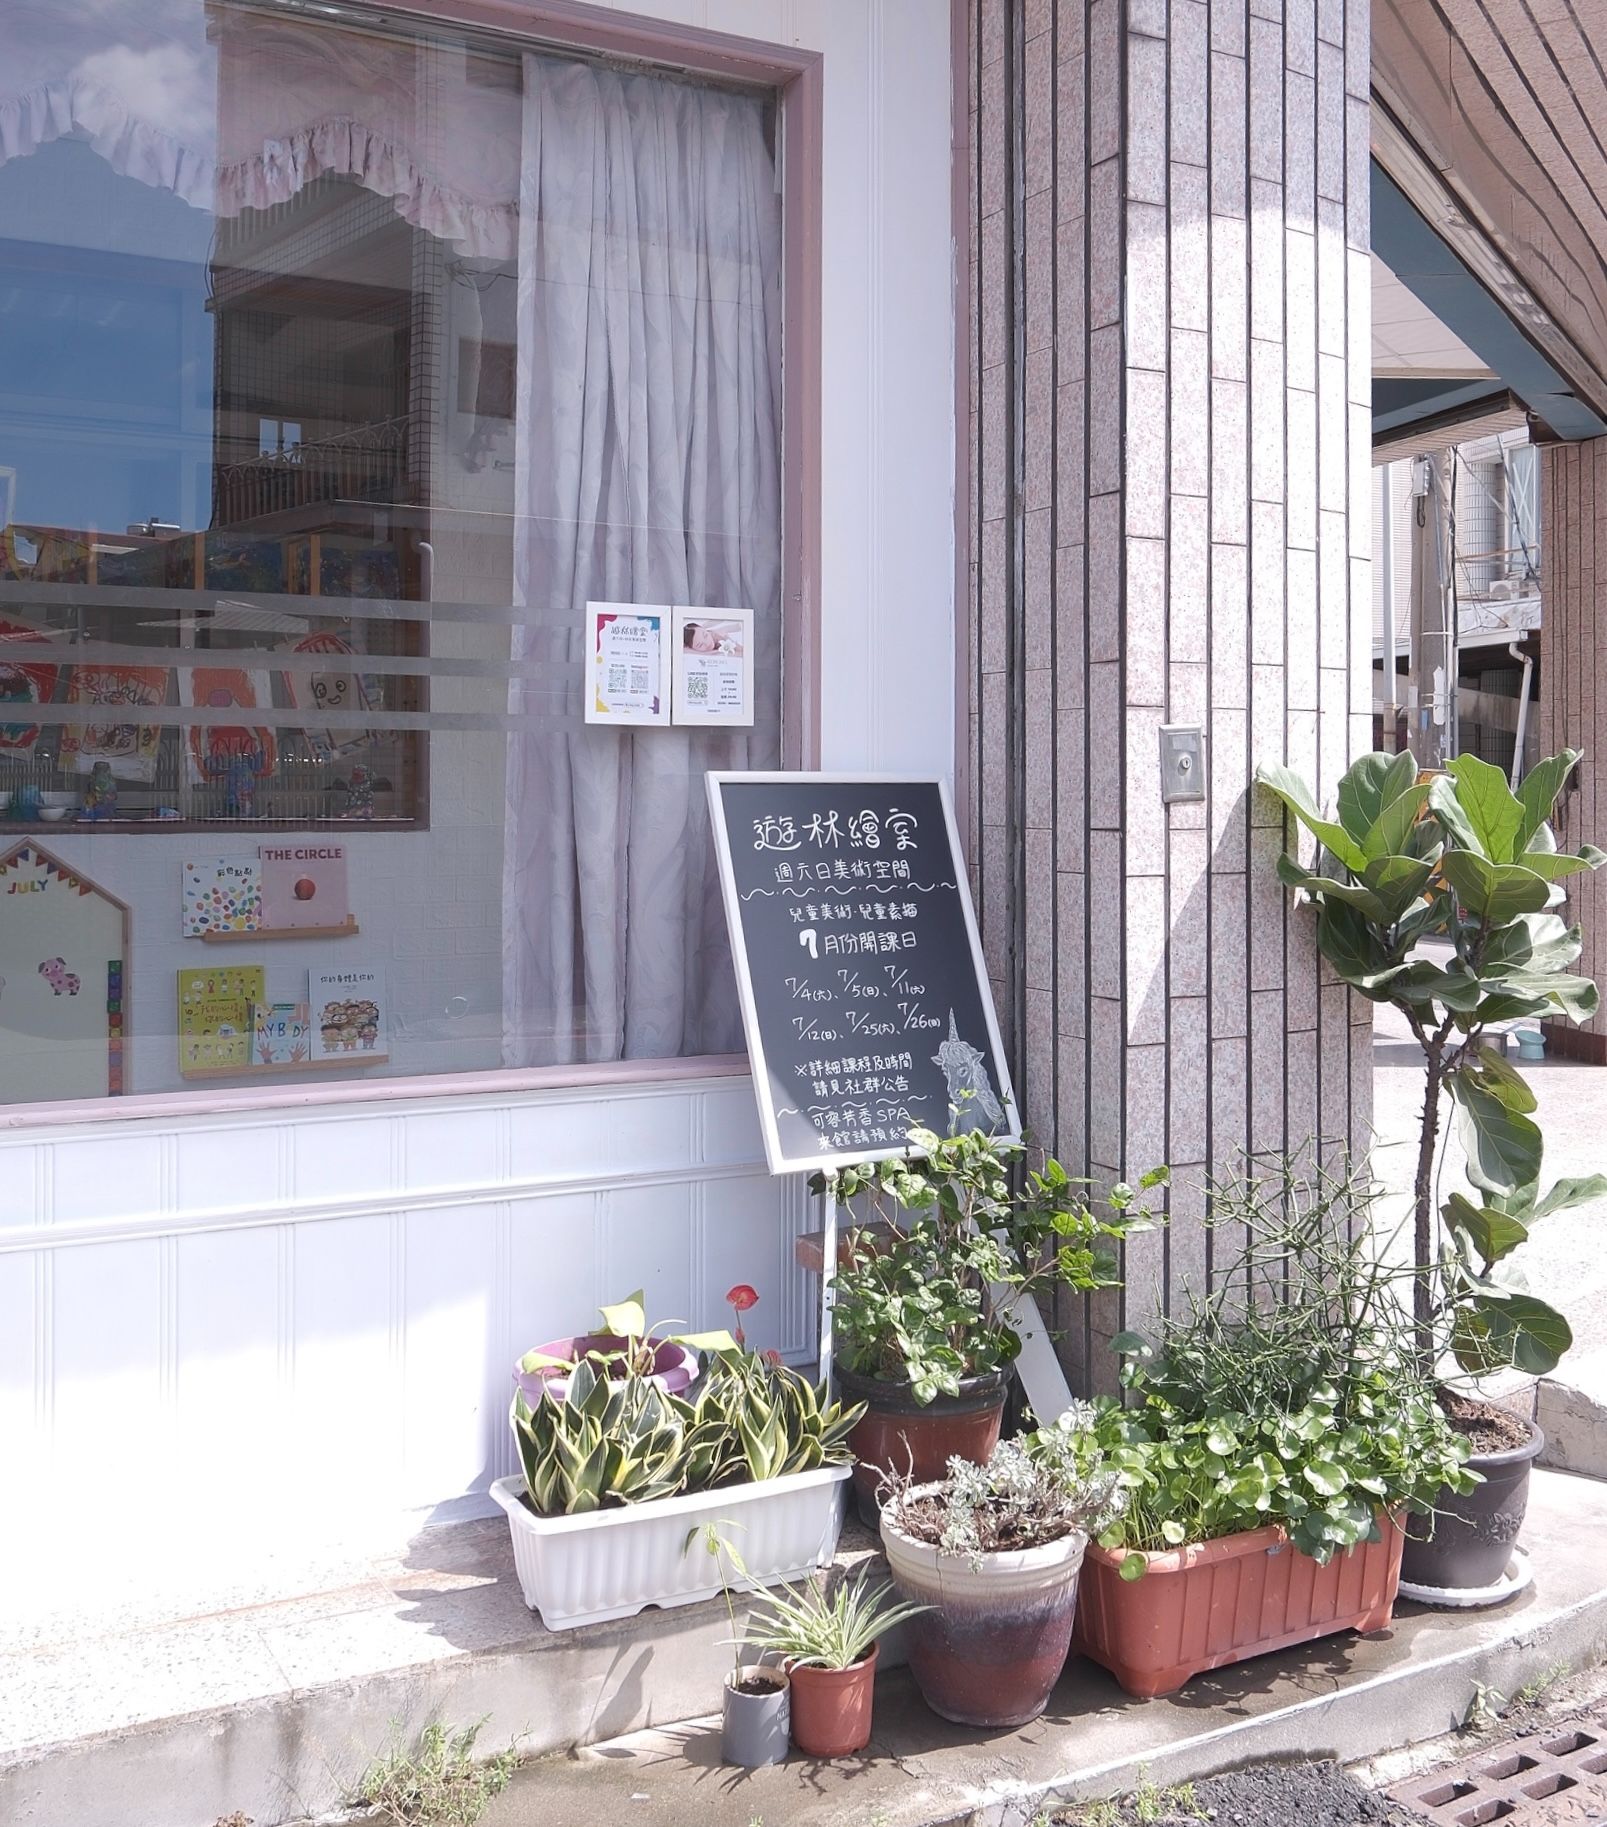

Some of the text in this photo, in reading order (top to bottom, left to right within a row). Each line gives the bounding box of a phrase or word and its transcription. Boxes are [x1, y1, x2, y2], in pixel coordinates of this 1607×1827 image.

[753, 808, 918, 851] 遊林繪室
[265, 848, 342, 860] THE CIRCLE
[774, 859, 911, 883] 週六日美術空間
[7, 879, 48, 895] JULY
[258, 1022, 309, 1040] MY BDY
[812, 1074, 910, 1098] 請見社群公告
[876, 1107, 911, 1122] SPA
